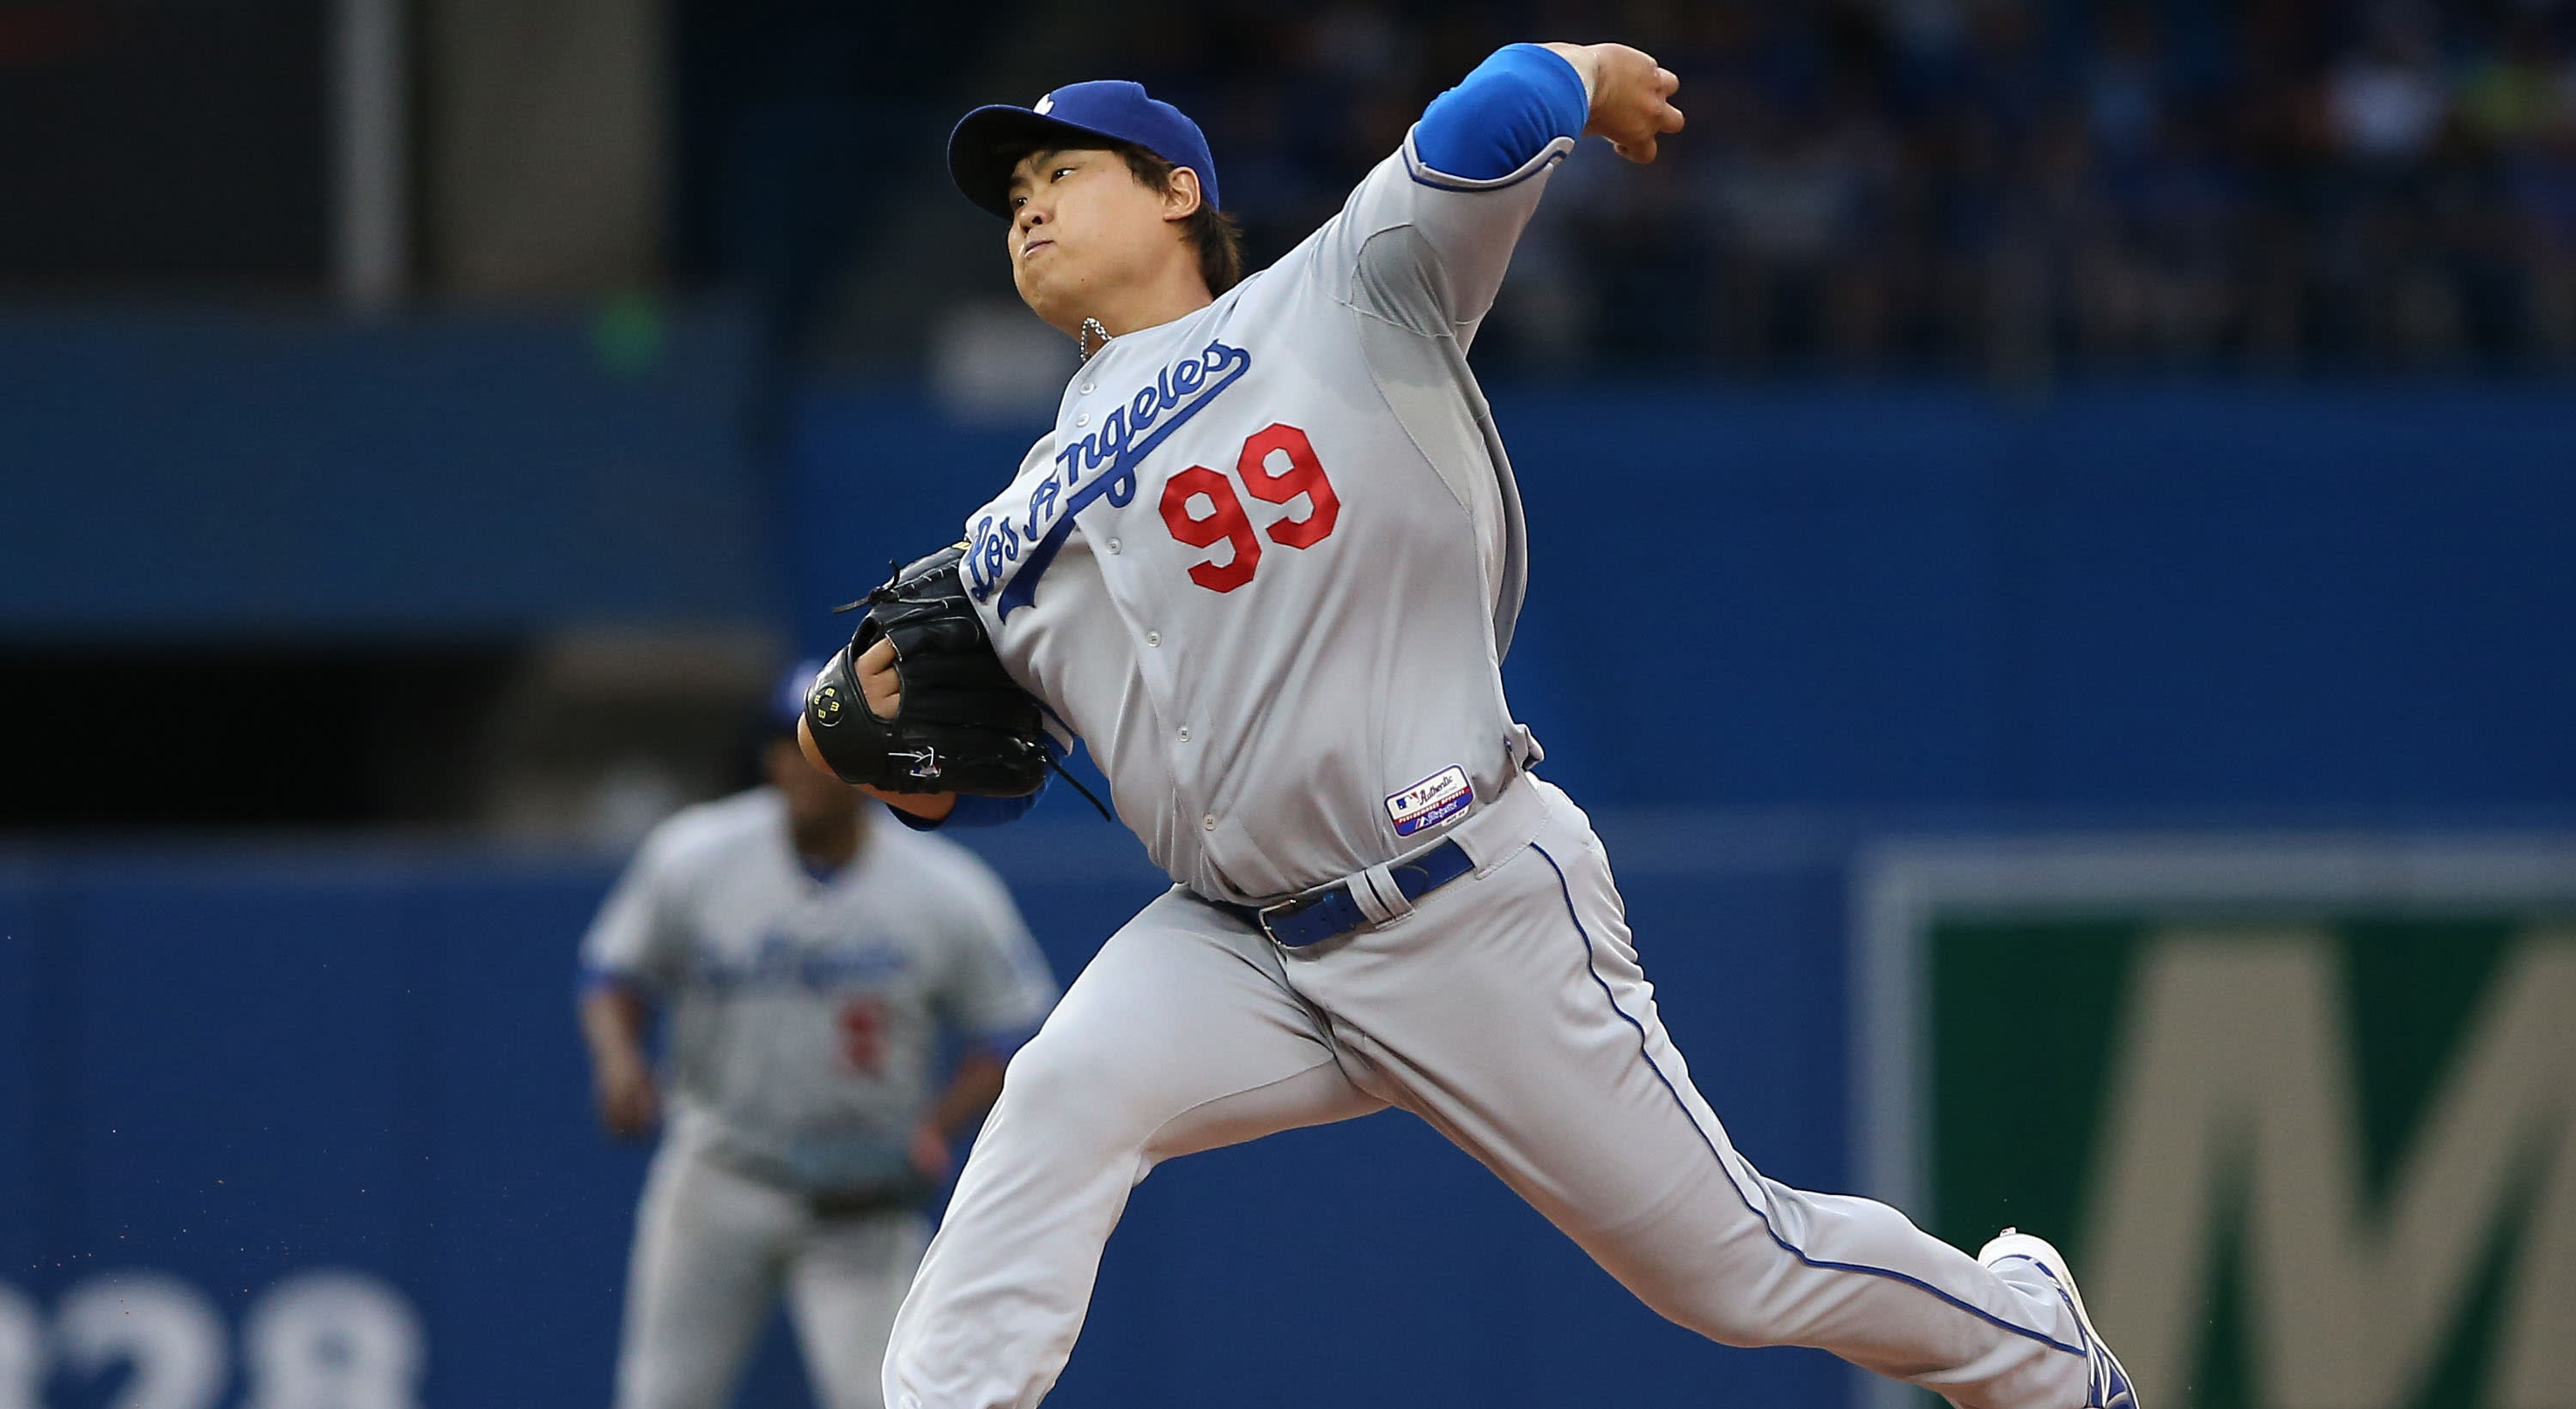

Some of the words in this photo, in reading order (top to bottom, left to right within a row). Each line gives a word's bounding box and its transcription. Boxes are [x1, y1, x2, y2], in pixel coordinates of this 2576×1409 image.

[970, 515, 1019, 603] Los
[1023, 340, 1251, 542] Angeles
[1158, 422, 1341, 593] 99
[1419, 776, 1453, 805] Authentic
